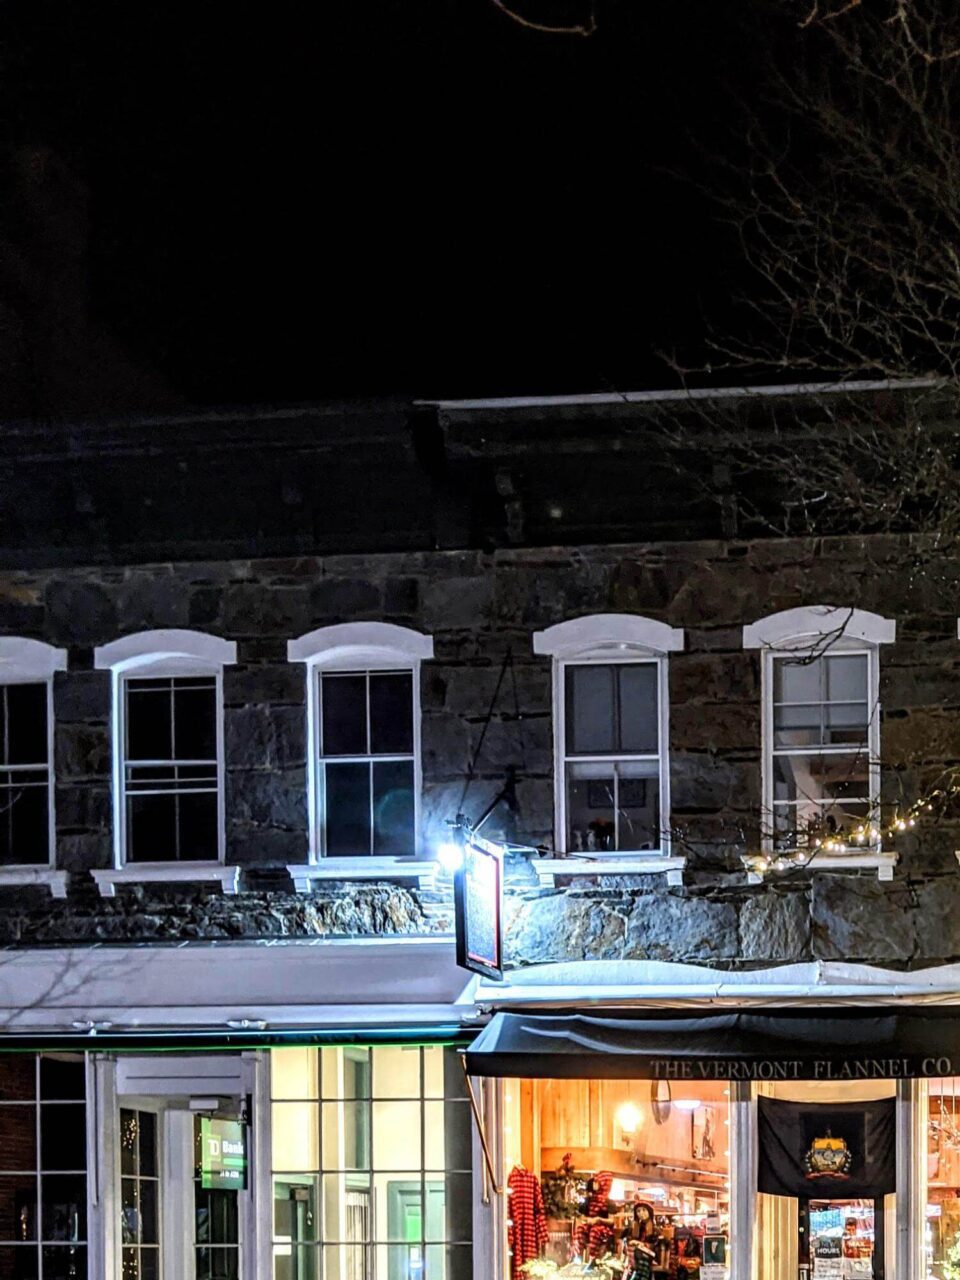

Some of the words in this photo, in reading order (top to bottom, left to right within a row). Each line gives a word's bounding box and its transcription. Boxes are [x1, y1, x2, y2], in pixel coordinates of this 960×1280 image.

[651, 1061, 693, 1079] THE
[700, 1061, 803, 1079] VERMONT
[814, 1059, 914, 1078] FLANNEL
[922, 1057, 955, 1076] CO.
[222, 1140, 244, 1155] Bank
